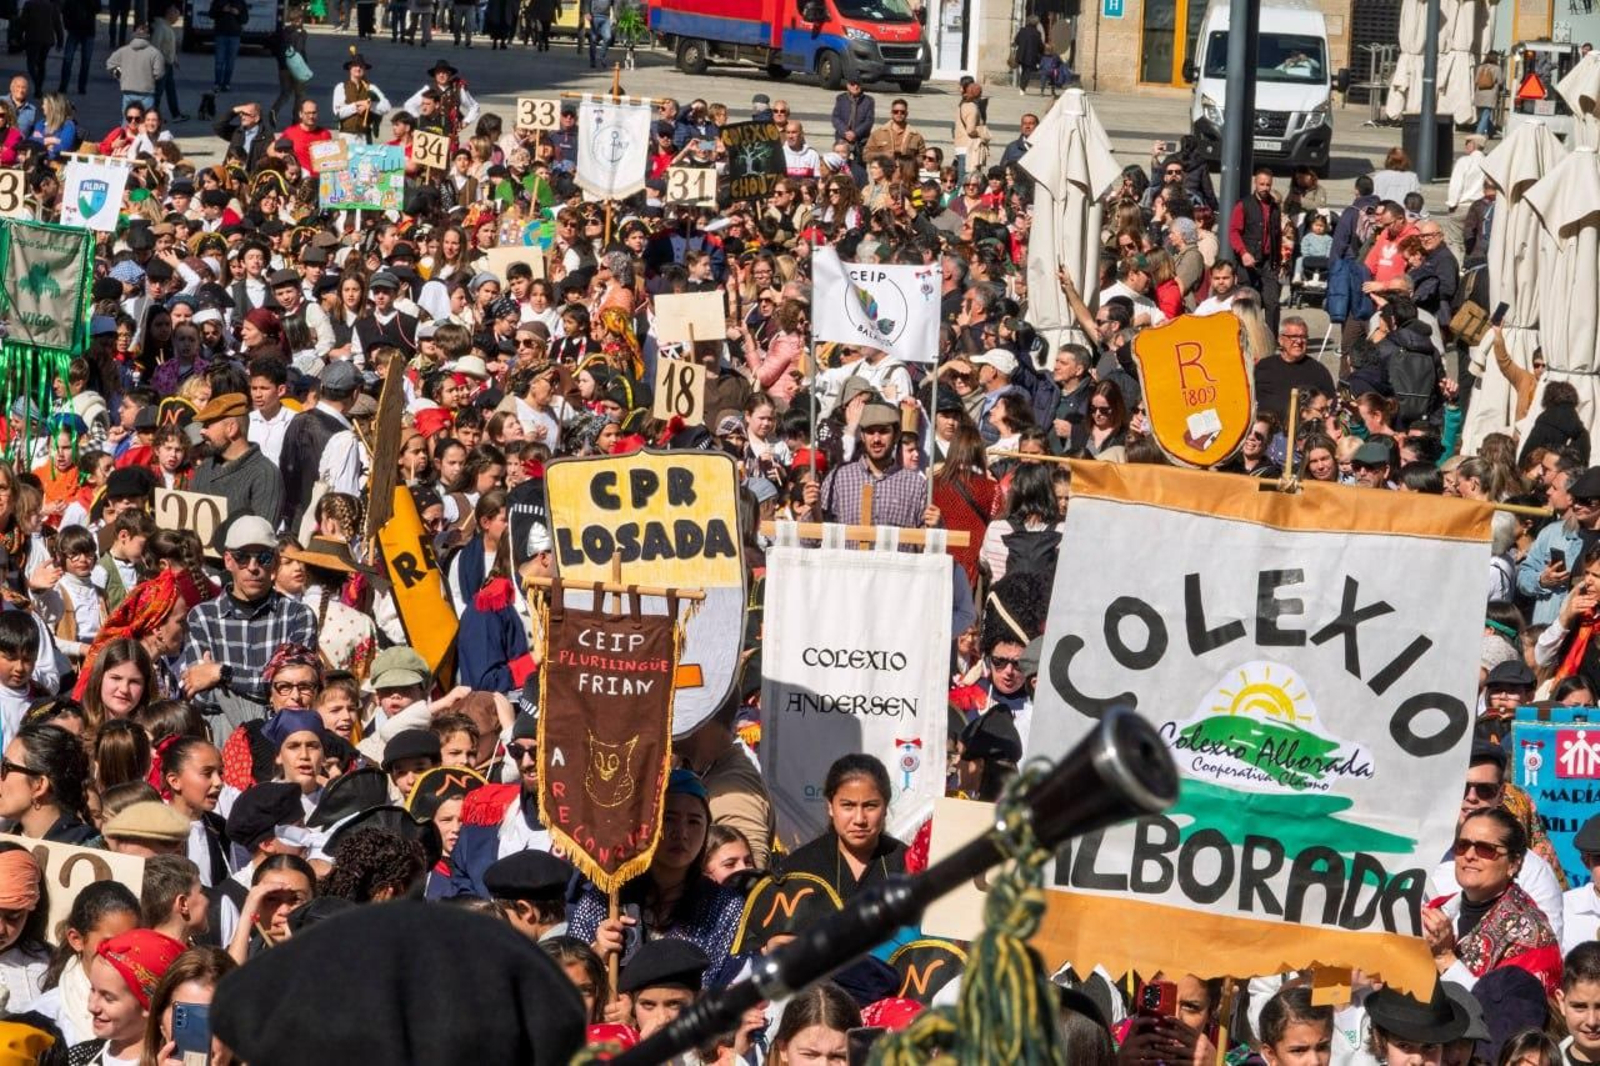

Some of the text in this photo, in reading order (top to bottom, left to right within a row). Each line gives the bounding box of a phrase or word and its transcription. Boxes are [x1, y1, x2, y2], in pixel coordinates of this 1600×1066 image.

[521, 100, 556, 126] 33
[414, 133, 444, 164] 34
[670, 169, 712, 200] 31
[731, 172, 780, 198] CHOUZ
[849, 270, 887, 283] CEIP
[22, 311, 53, 327] VIGO
[1175, 342, 1217, 388] R
[662, 362, 695, 418] 18
[1182, 386, 1216, 406] 1809
[162, 408, 185, 427] N
[590, 467, 697, 510] CPR
[556, 519, 737, 566] LOSADA
[578, 629, 645, 652] CEIP
[559, 650, 669, 673] PLURILINGÜE
[802, 647, 907, 671] COLEXIO
[1049, 568, 1470, 758] COLEXIO
[578, 673, 654, 696] FRIAN
[786, 692, 919, 722] ANDERSEN
[1159, 721, 1374, 779] Colexio Alborada
[1192, 756, 1273, 783] Cooperativa
[1055, 813, 1427, 937] LBORADA
[762, 887, 815, 928] N
[898, 959, 945, 998] N
